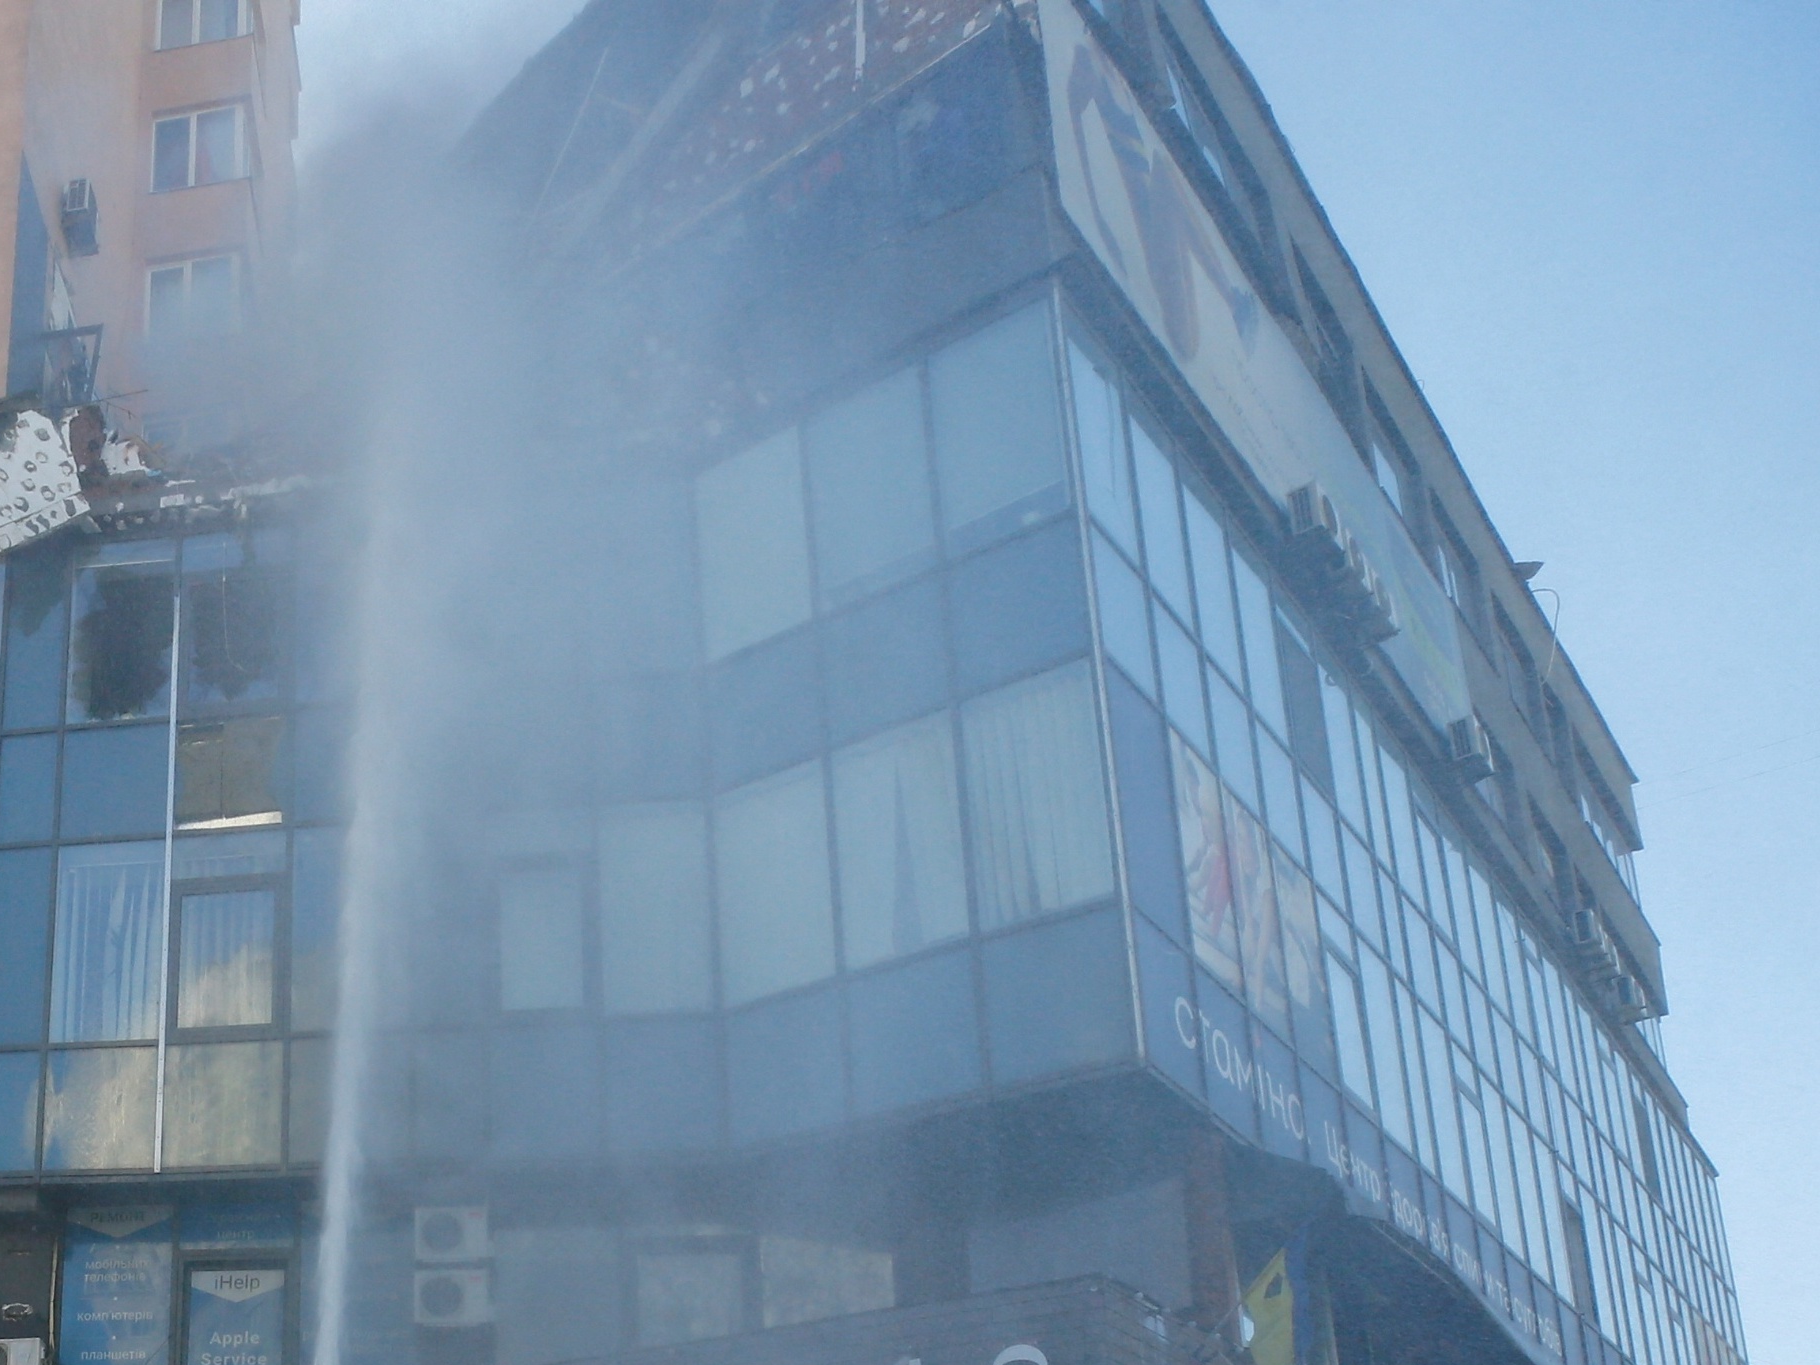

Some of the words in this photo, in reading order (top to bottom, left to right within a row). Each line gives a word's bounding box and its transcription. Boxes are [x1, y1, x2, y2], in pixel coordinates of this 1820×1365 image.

[84, 1258, 150, 1271] мобільних
[83, 1270, 147, 1285] телефонів
[213, 1274, 261, 1292] iHelp
[209, 1331, 260, 1348] Apple
[80, 1348, 147, 1362] планшетів
